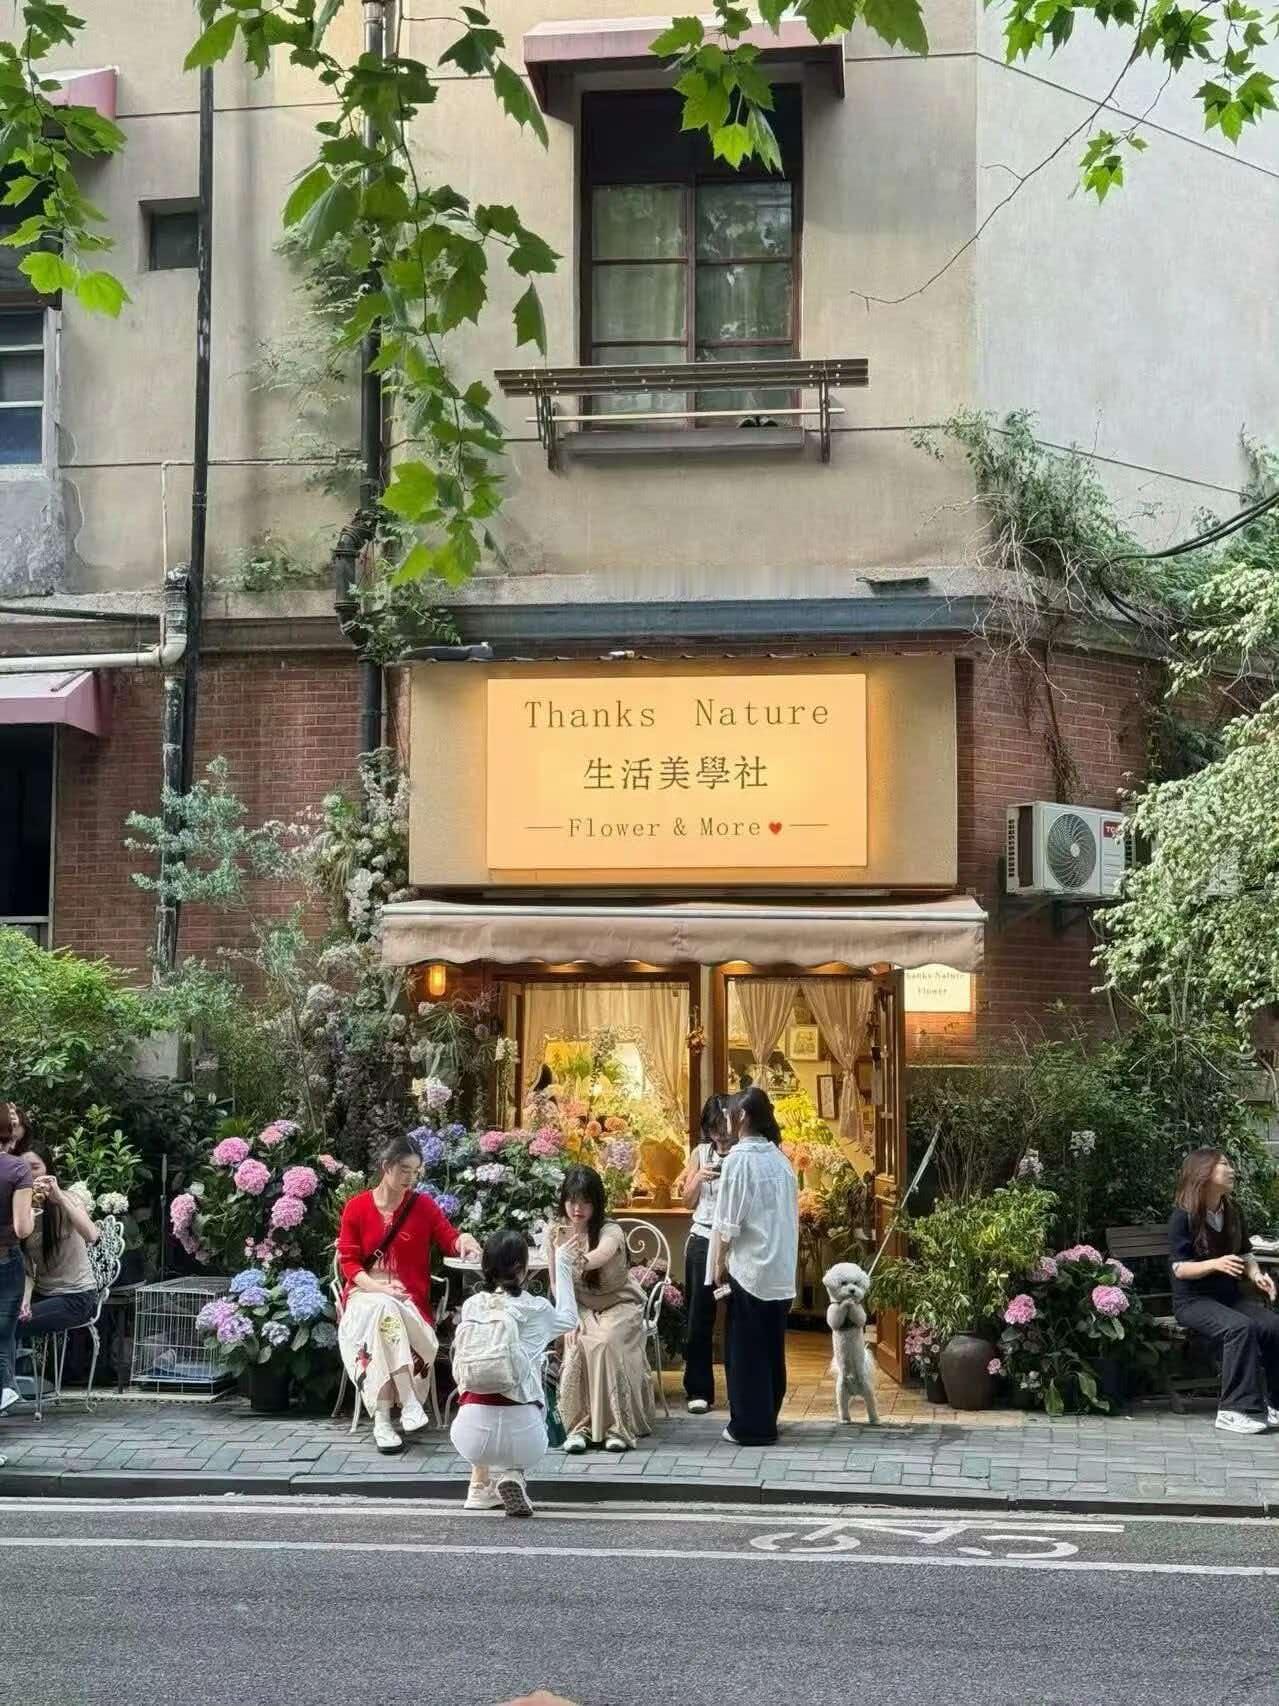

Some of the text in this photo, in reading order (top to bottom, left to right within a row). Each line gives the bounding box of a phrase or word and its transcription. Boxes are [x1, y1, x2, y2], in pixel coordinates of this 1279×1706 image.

[524, 698, 829, 728] Thanks Nature
[583, 755, 769, 791] 生活美學社
[569, 817, 761, 838] Flower & More
